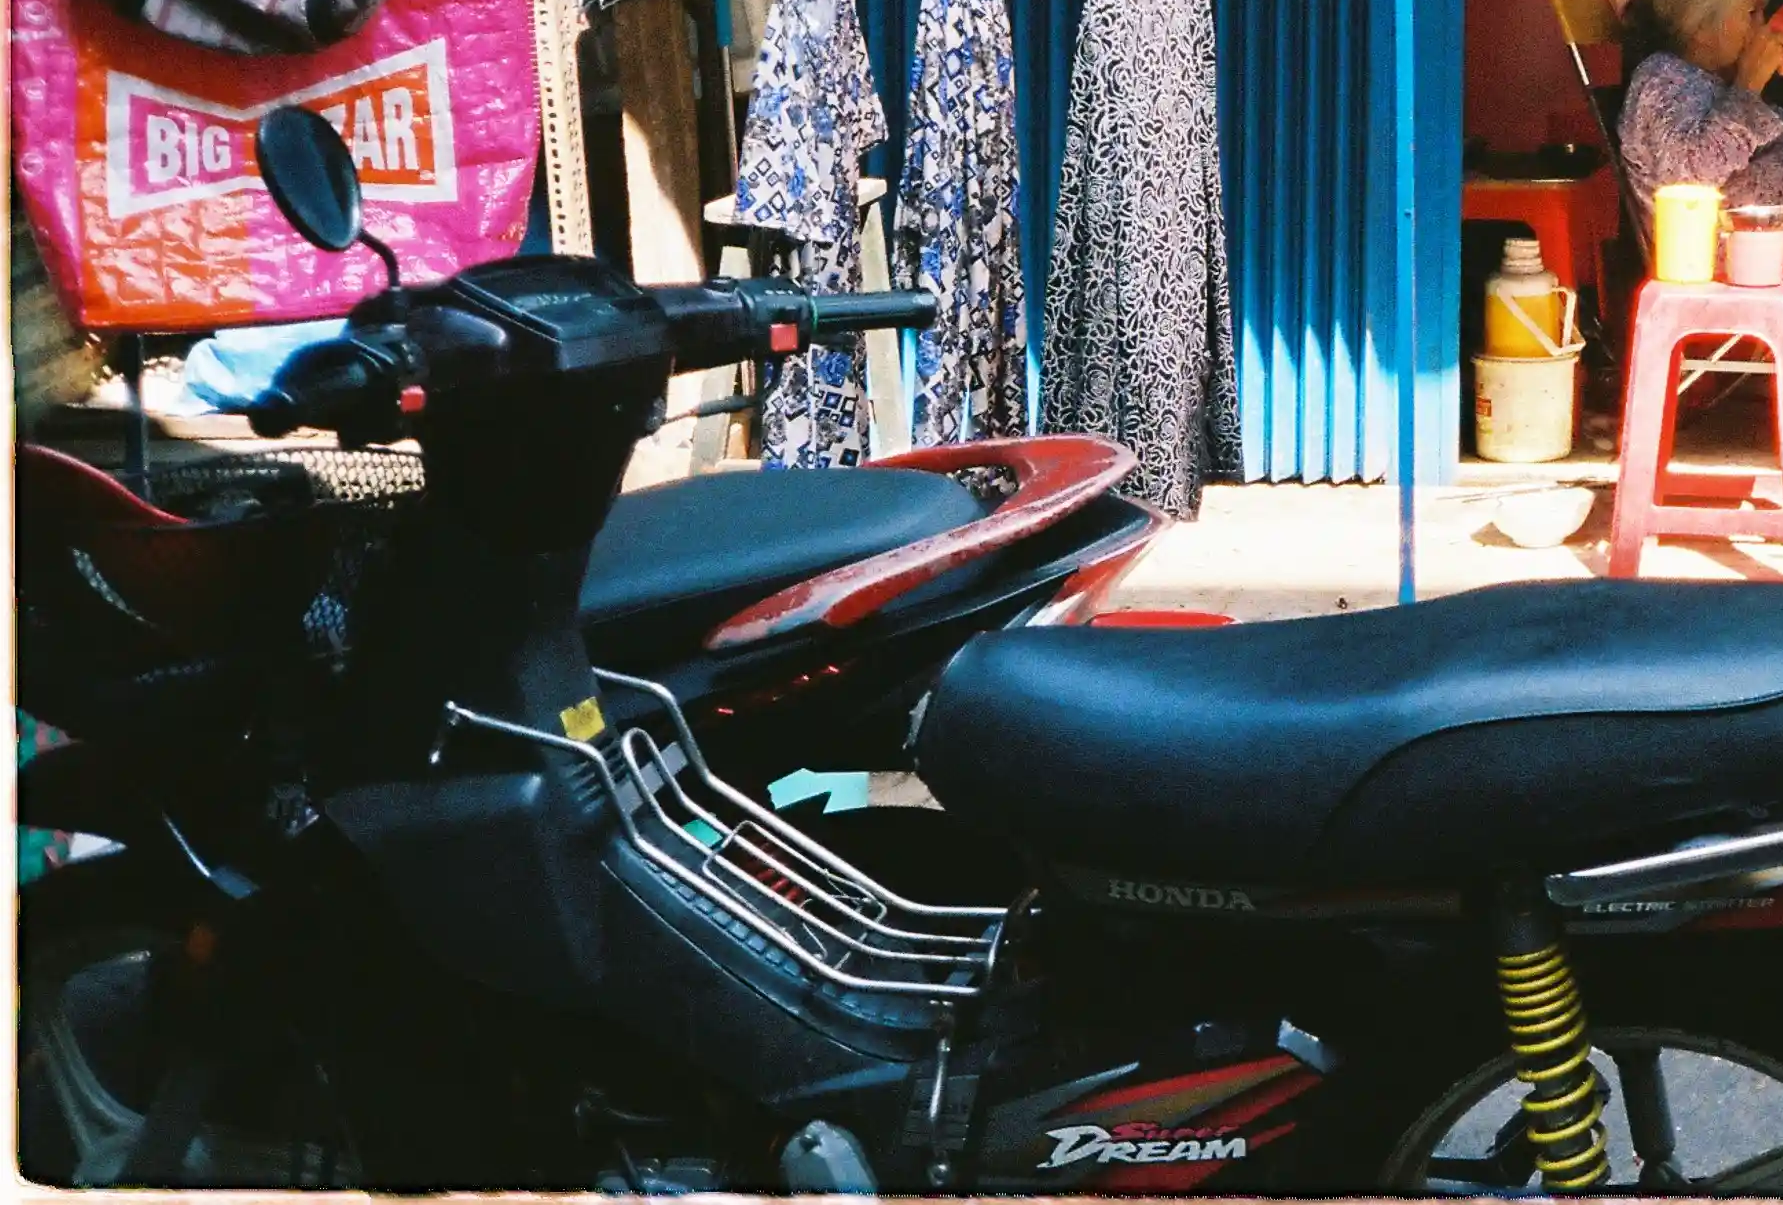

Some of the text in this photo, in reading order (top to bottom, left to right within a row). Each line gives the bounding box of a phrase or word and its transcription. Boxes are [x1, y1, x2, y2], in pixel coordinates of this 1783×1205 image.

[146, 114, 232, 184] BIG
[1107, 878, 1257, 912] HONDA
[1583, 900, 1677, 914] ELECTRIC
[1036, 1124, 1247, 1169] DREAM
